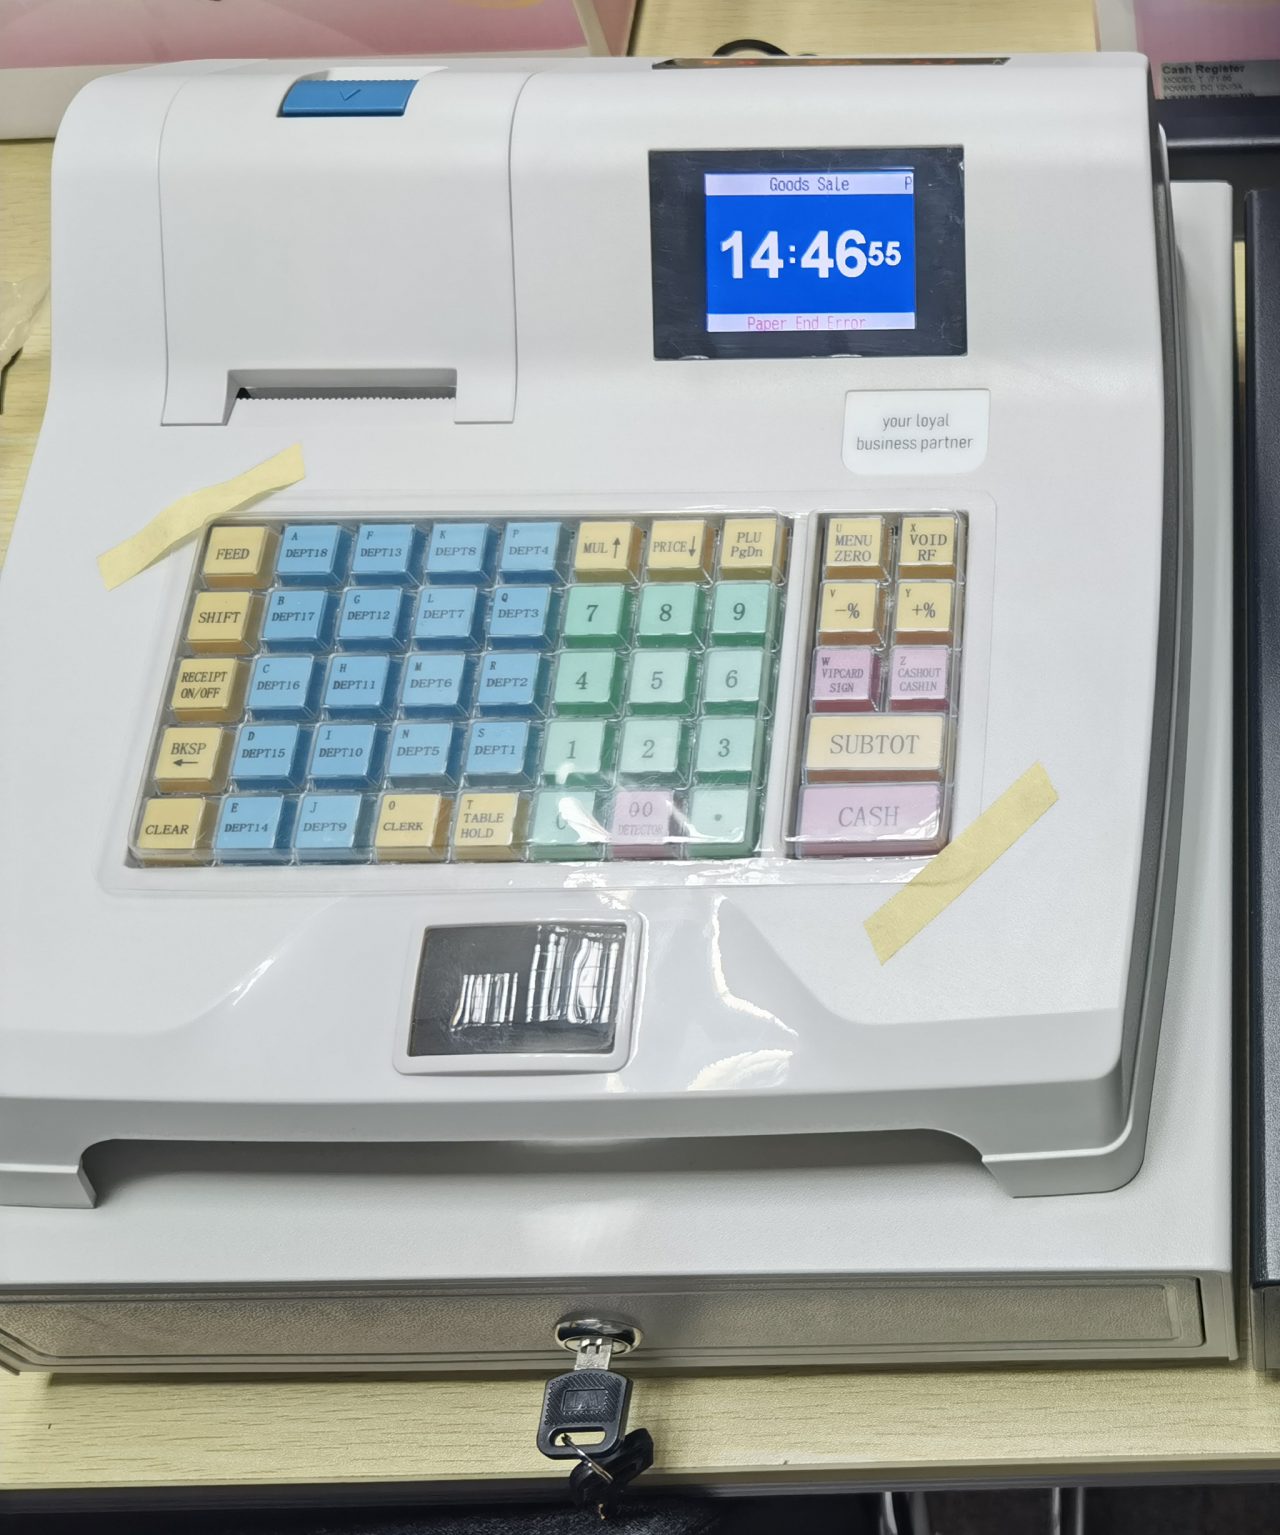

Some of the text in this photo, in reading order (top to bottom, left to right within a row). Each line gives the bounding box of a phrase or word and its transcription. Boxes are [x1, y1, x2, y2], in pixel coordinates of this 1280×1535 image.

[1161, 63, 1246, 75] Cash Register
[769, 177, 850, 192] Goods Sale
[747, 315, 867, 332] Paper End Error
[881, 412, 951, 432] your loyal
[856, 435, 974, 453] business partner
[735, 530, 762, 545] PLU
[835, 533, 873, 547] MENU
[909, 533, 948, 547] VOID
[215, 547, 250, 561] FEED
[285, 547, 329, 559] DEPT18
[359, 546, 403, 558] DEPT13
[434, 545, 477, 557] DEPT8
[508, 544, 550, 556] DEPT4
[582, 540, 610, 555] MUL
[652, 540, 688, 554] PRICE
[729, 545, 764, 560] PgDn
[834, 549, 872, 563] ZERO
[916, 548, 938, 562] RF
[198, 610, 242, 625] SHIFT
[271, 611, 316, 623] DEPT17
[346, 610, 391, 622] DEPT12
[422, 608, 465, 620] DEPT7
[496, 607, 540, 619] DEPT3
[585, 604, 599, 623] 7
[658, 603, 673, 622] 8
[732, 602, 746, 622] 9
[181, 671, 229, 684] RECEIPT
[724, 669, 739, 688] 6
[821, 666, 865, 680] VIPCARD
[898, 666, 942, 679] CASHOUT
[256, 679, 301, 692] DEPT16
[331, 679, 376, 691] DEPT11
[409, 678, 453, 689] DEPT6
[485, 676, 529, 688] DEPT2
[574, 671, 589, 690] 4
[650, 670, 664, 690] 5
[899, 680, 938, 693] CASHIN
[180, 686, 221, 700] ON/OFF
[829, 681, 855, 694] SIGN
[170, 742, 207, 756] BKSP
[396, 745, 441, 757] DEPT5
[473, 744, 517, 756] DEPT1
[566, 740, 578, 760] 1
[641, 739, 655, 758] 2
[717, 738, 731, 758] 3
[829, 733, 921, 756] SUBTOT
[241, 747, 286, 759] DEPT15
[318, 746, 364, 758] DEPT10
[628, 801, 654, 818] 00
[837, 805, 901, 828] CASH
[463, 811, 505, 824] TABLE
[144, 823, 190, 837] CLEAR
[224, 822, 269, 834] DEPT14
[302, 821, 348, 833] DEPT9
[382, 820, 425, 833] CLERK
[460, 826, 495, 839] HOLD
